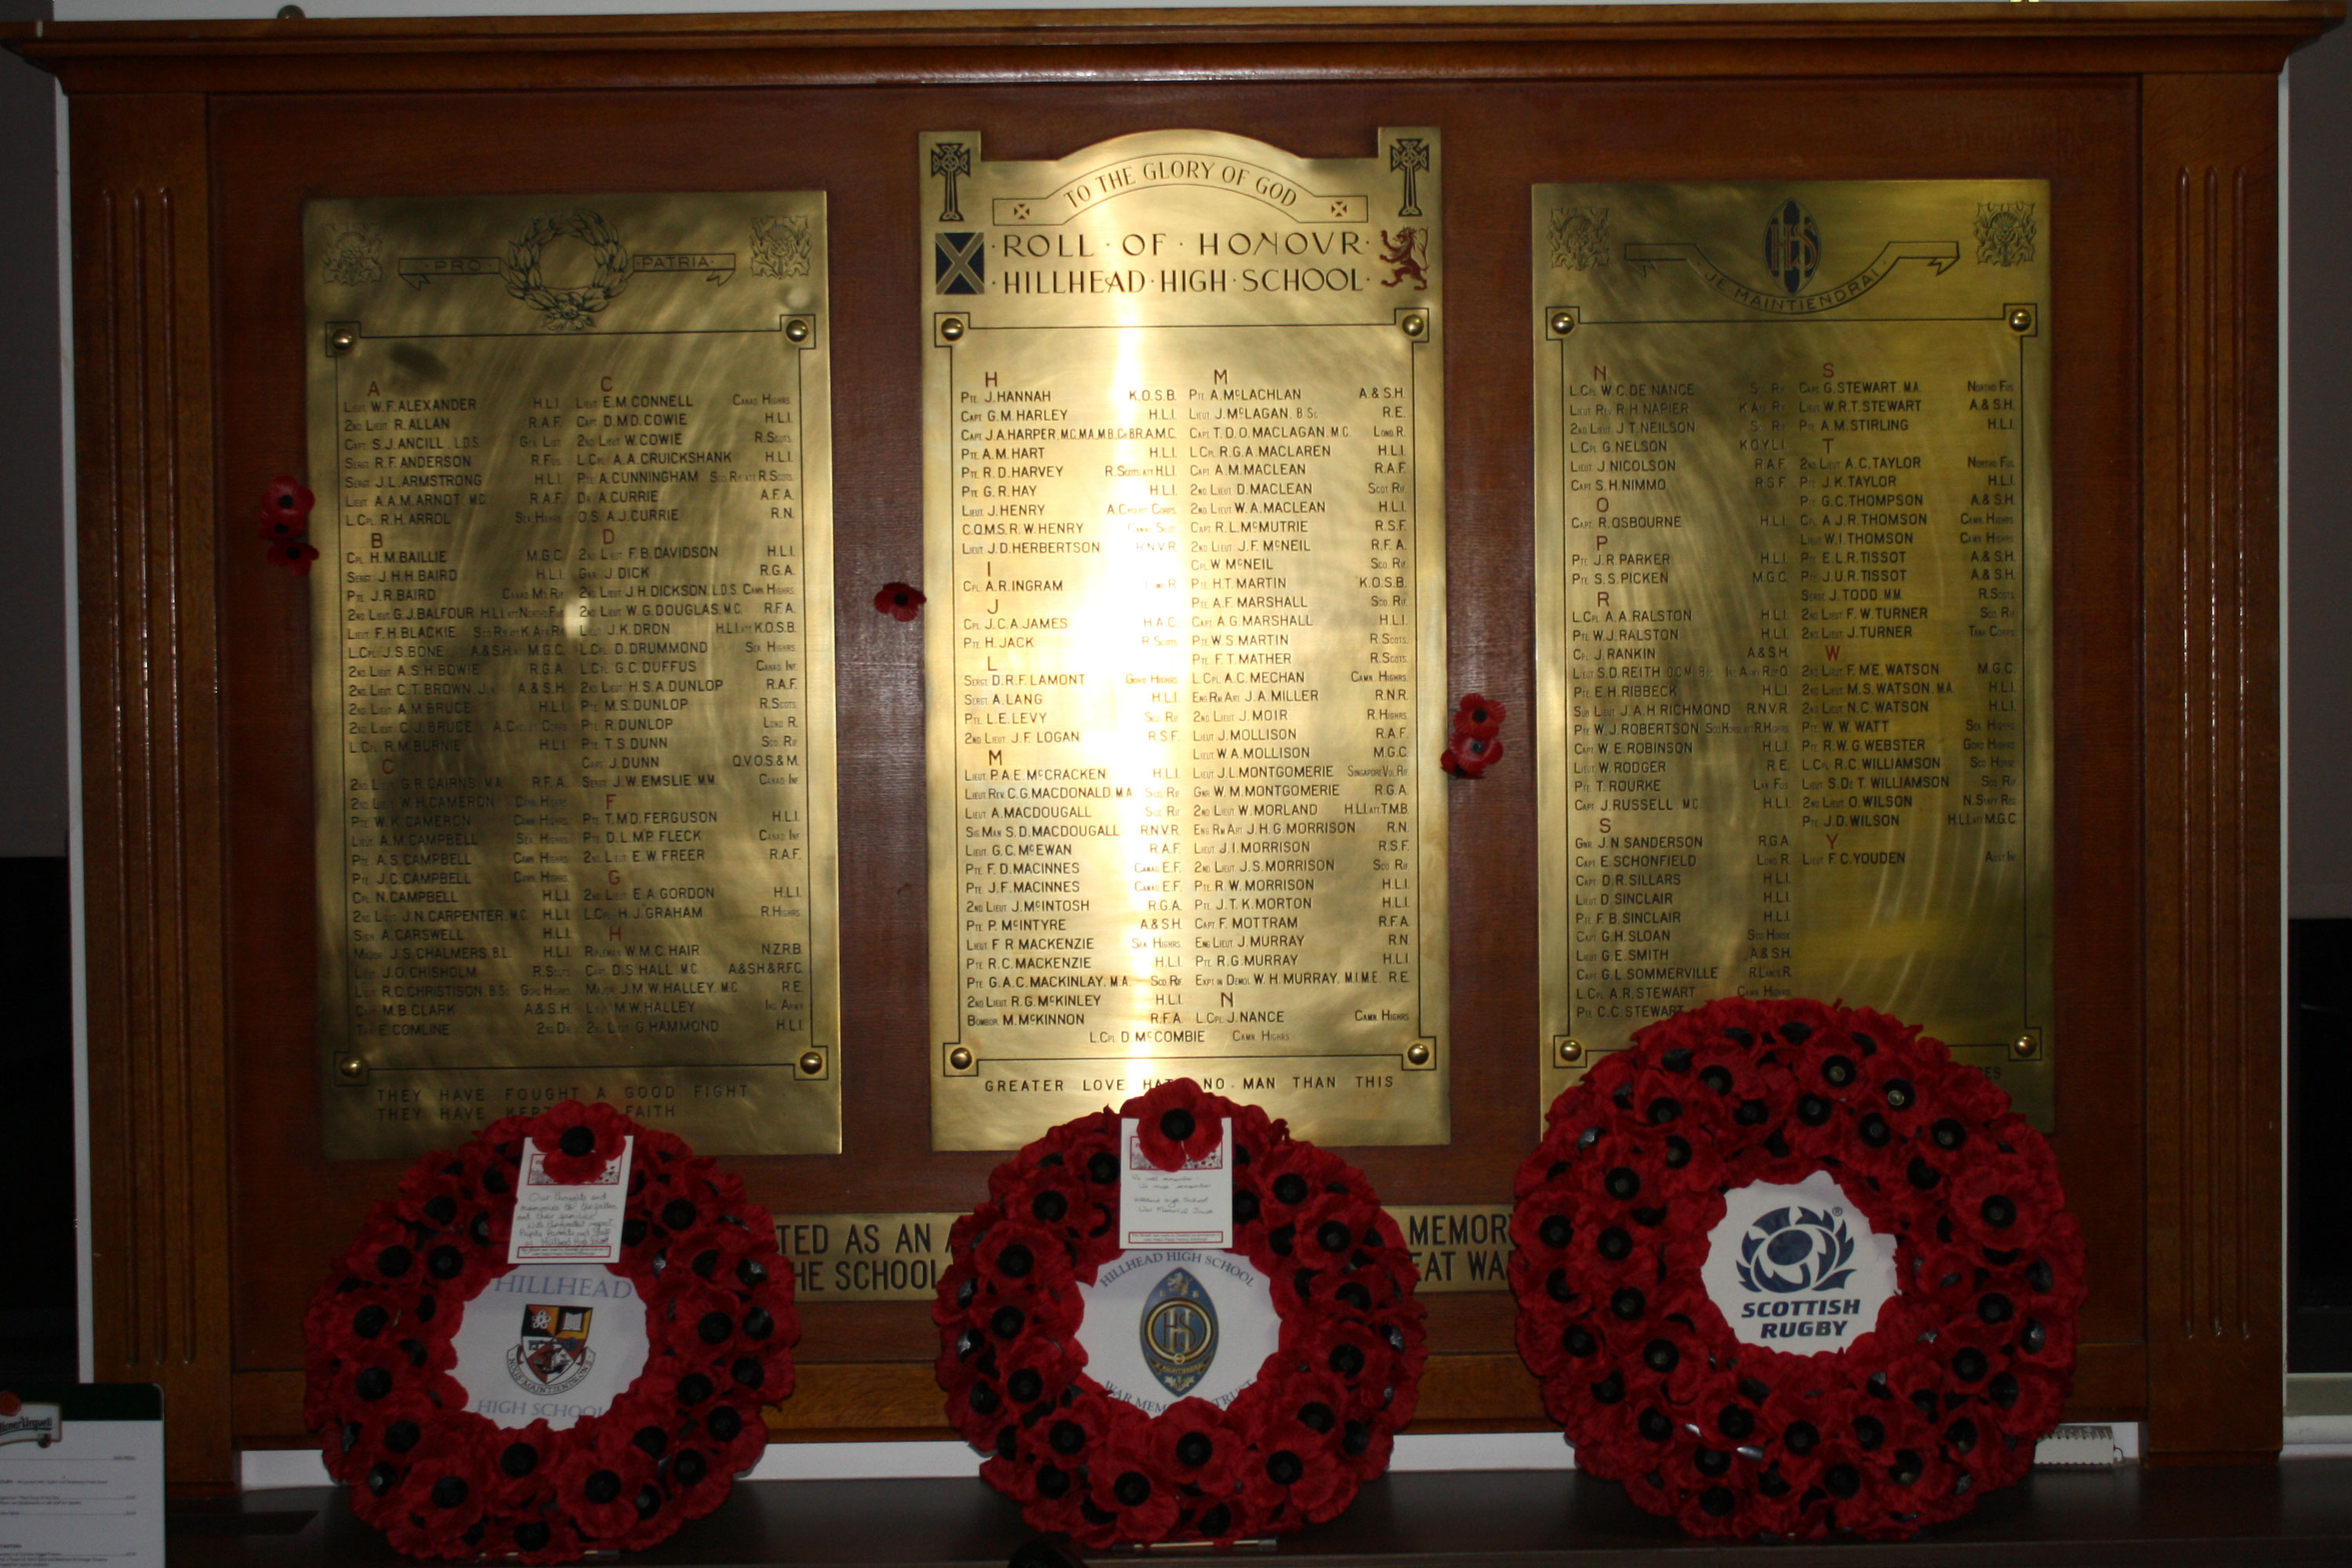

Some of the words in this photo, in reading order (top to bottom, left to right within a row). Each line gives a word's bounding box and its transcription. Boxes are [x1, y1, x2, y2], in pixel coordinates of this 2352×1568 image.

[1064, 184, 1091, 209] TO
[1094, 172, 1137, 193] THE
[1143, 162, 1216, 181] GLORY
[1222, 165, 1247, 186] OF
[1255, 176, 1298, 208] GOD
[1004, 234, 1094, 257] ROLL
[1123, 234, 1166, 256] OF
[434, 260, 481, 271] PRO
[642, 256, 710, 269] PATRIA
[1005, 270, 1145, 293] HILLHEAD
[1162, 270, 1225, 292] HIGH
[1243, 268, 1361, 292] SCHOOL
[1704, 272, 1726, 290] JE
[377, 1089, 421, 1102] THEY
[440, 1088, 485, 1104] HAVE
[506, 1087, 579, 1101] FOUGHT
[597, 1087, 606, 1099] A
[625, 1086, 674, 1099] GOOD
[695, 1083, 747, 1098] FIGHT
[985, 1080, 1063, 1091] GREATER
[1083, 1080, 1123, 1091] LOVE
[1204, 1078, 1224, 1089] NO
[1243, 1078, 1274, 1089] MAN
[1293, 1076, 1335, 1088] THAN
[1356, 1076, 1392, 1087] THIS
[376, 1108, 422, 1121] THEY
[441, 1107, 485, 1120] HAVE
[624, 1104, 674, 1118] FAITH
[776, 1225, 829, 1255] TED
[846, 1225, 880, 1254] AS
[895, 1223, 931, 1254] AN
[1410, 1214, 1511, 1245] MEMOR
[836, 1259, 937, 1290] SCHOOL
[1100, 1254, 1163, 1287] HILLHEAD
[1167, 1252, 1202, 1264] HIGH
[1205, 1255, 1254, 1287] SCHOOL
[494, 1276, 633, 1299] HILLHEAD
[1741, 1299, 1860, 1318] SCOTTISH
[1761, 1321, 1849, 1339] RUGBY
[477, 1400, 527, 1415] HIGH
